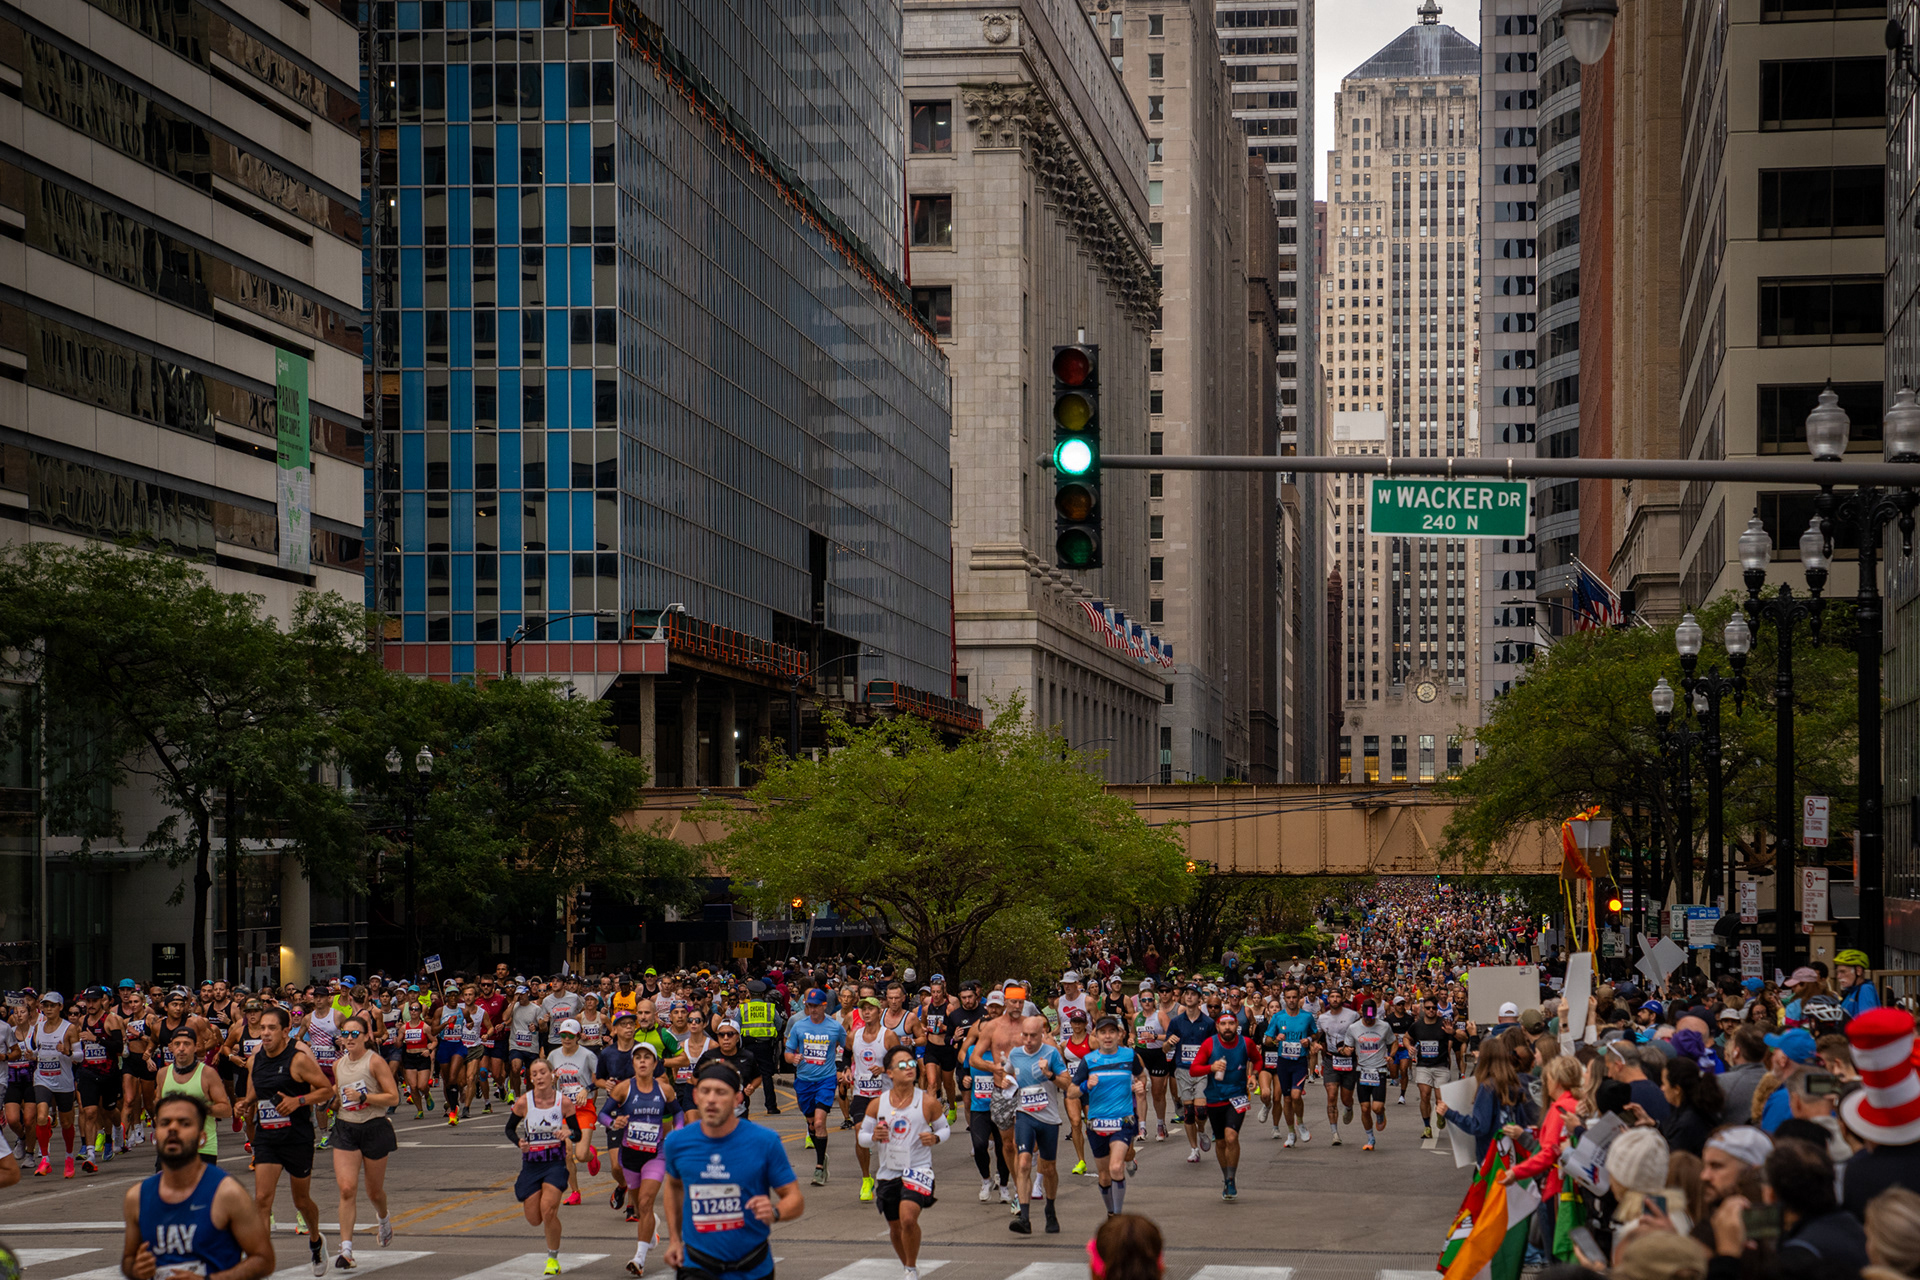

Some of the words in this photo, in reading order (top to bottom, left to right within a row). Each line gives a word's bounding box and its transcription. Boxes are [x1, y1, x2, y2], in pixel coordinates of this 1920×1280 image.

[1378, 489, 1391, 504] W
[1397, 486, 1493, 509] WACKER
[1498, 492, 1521, 507] DR
[1422, 515, 1456, 530] 240
[1467, 515, 1478, 530] N
[1369, 715, 1410, 723] CHICAGO
[1412, 715, 1441, 723] BOARD
[427, 962, 440, 970] 3:20
[804, 1032, 829, 1040] Team
[42, 1061, 59, 1069] 20557
[863, 1080, 882, 1088] 13529
[1027, 1094, 1047, 1103] 22404
[633, 1107, 660, 1115] ANDRÉIA
[1100, 1119, 1121, 1127] 19461
[628, 1130, 633, 1138] D
[635, 1130, 658, 1141] 15497
[903, 1167, 910, 1176] D
[691, 1200, 700, 1214] D
[702, 1198, 742, 1214] 12482
[152, 1223, 197, 1255] JAY
